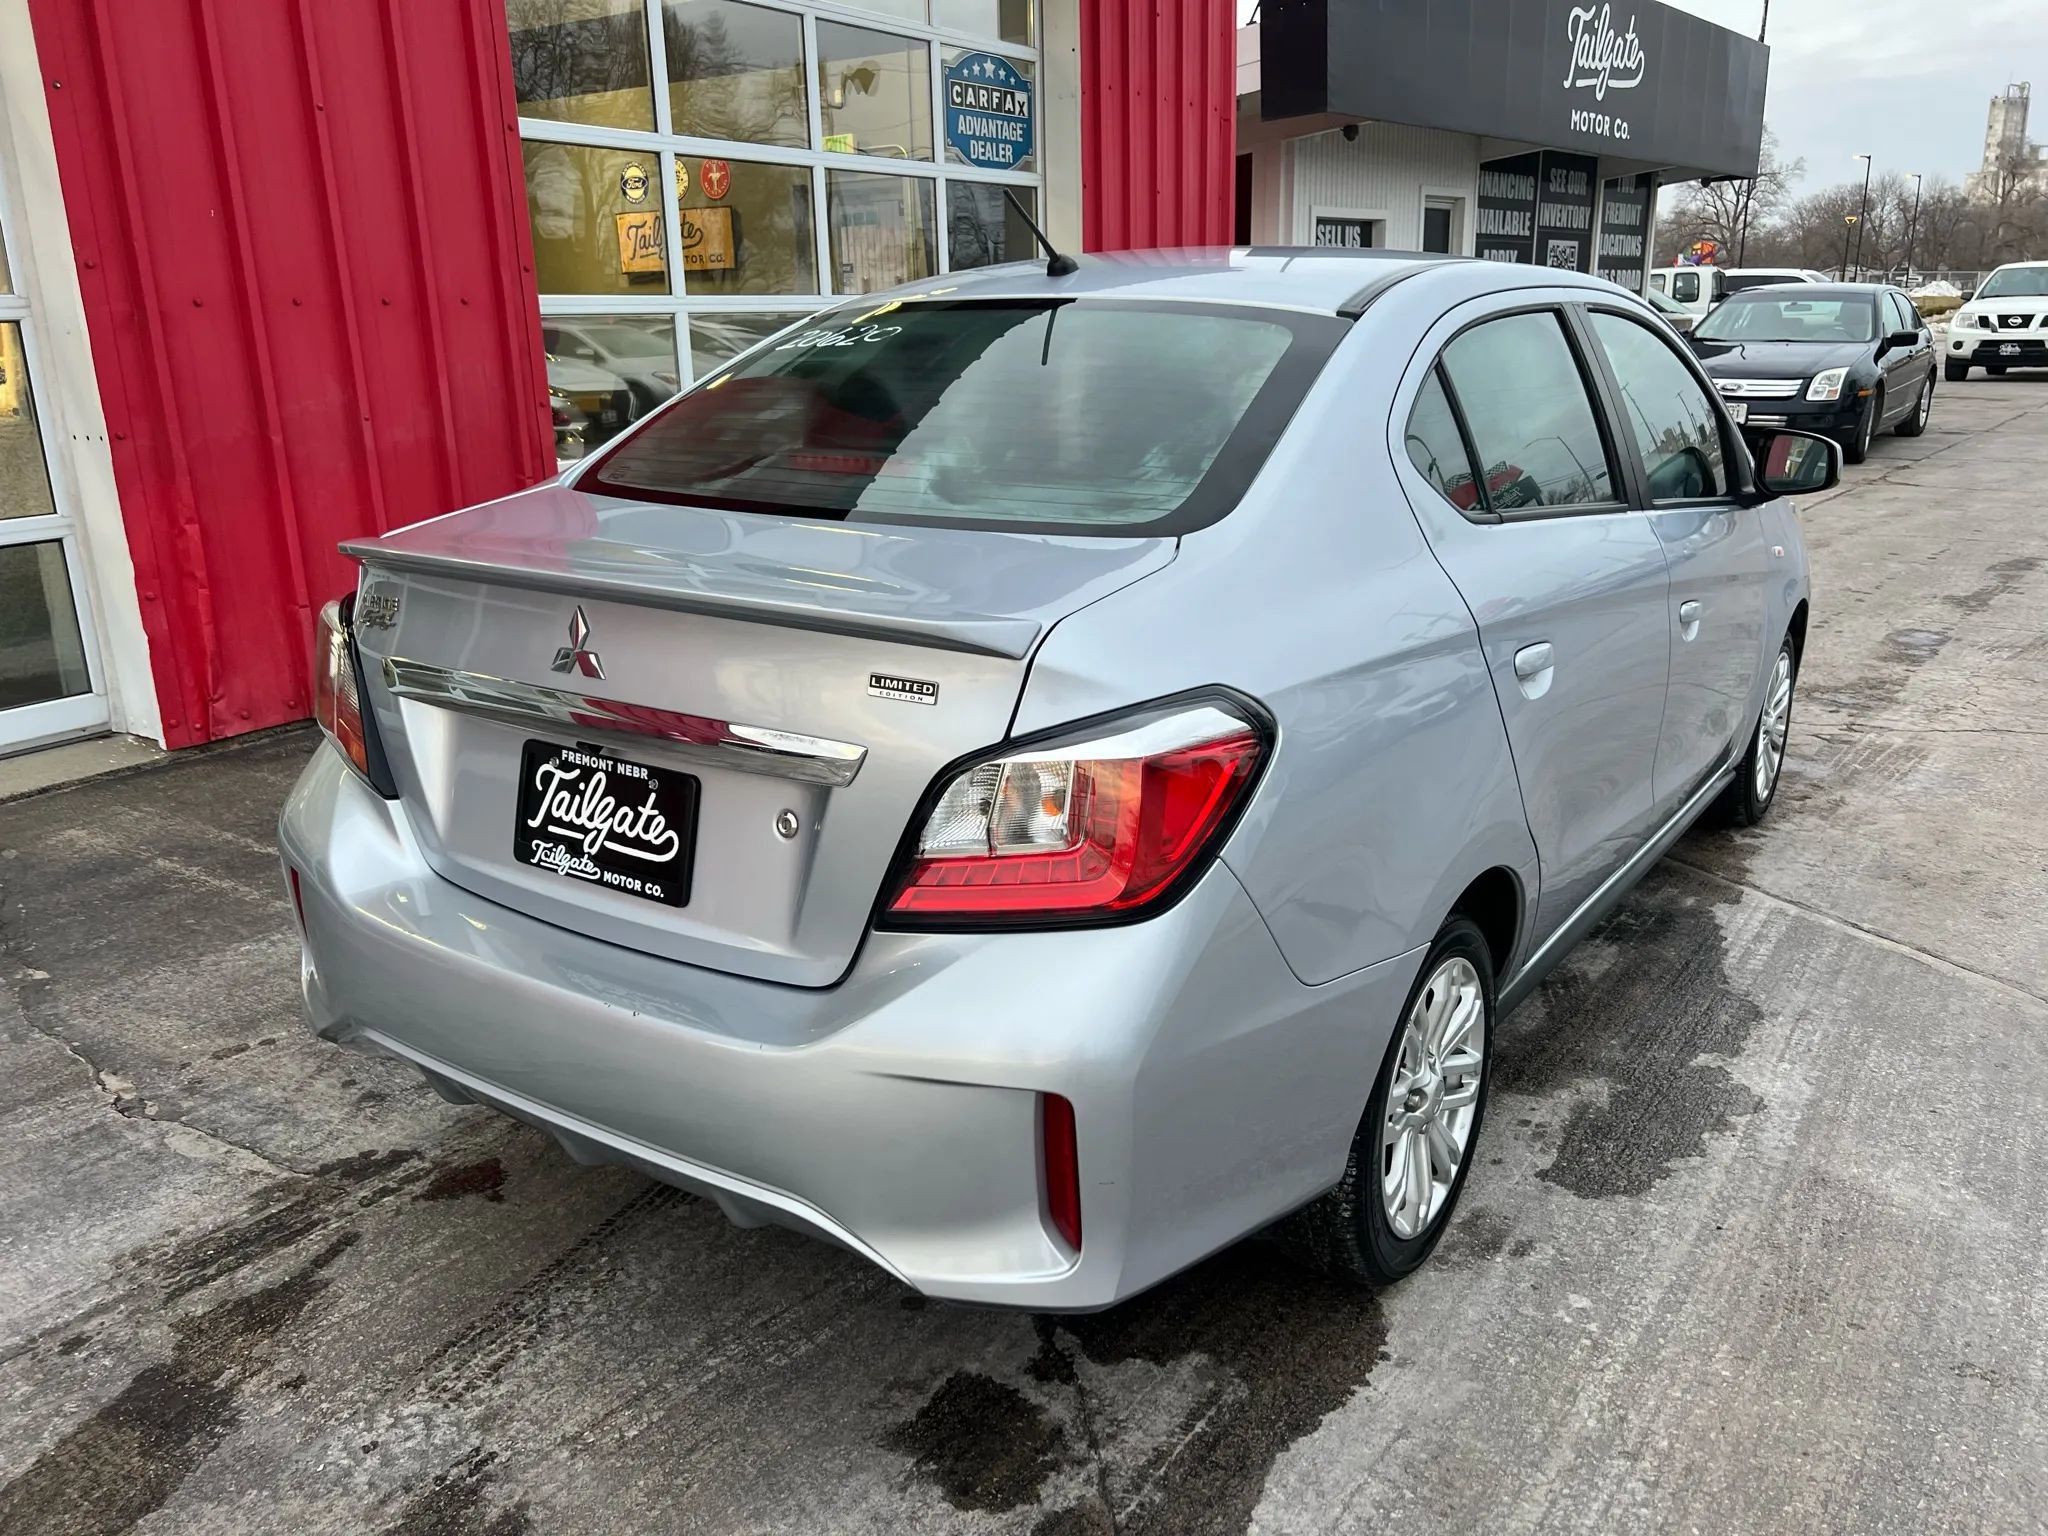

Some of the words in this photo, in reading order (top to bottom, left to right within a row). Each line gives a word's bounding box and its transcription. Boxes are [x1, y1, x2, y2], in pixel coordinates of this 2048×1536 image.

[1563, 2, 1645, 101] Tailgate
[952, 85, 1026, 117] CARFAX
[957, 114, 1024, 142] ADVANTAGE
[1570, 108, 1610, 137] MOTOR
[970, 139, 1013, 164] DEALER
[1479, 170, 1535, 201] INANCING
[1549, 167, 1567, 194] SEE
[1568, 170, 1588, 196] OUR
[1539, 202, 1592, 230] INVENTORY
[1605, 201, 1642, 226] FREMONT
[627, 215, 704, 261] Tailte
[1316, 224, 1342, 248] SELL
[1345, 225, 1361, 248] US
[1599, 233, 1642, 257] LOCATIONS
[685, 254, 705, 264] TOR
[871, 676, 934, 694] LIMITED
[879, 690, 923, 702] EDITION
[561, 749, 614, 772] FREMONT
[617, 762, 649, 781] NEBR
[527, 763, 679, 862] Tailgate
[530, 839, 601, 880] Tailgate
[603, 870, 642, 892] MOTOR
[645, 882, 665, 898] CO.
